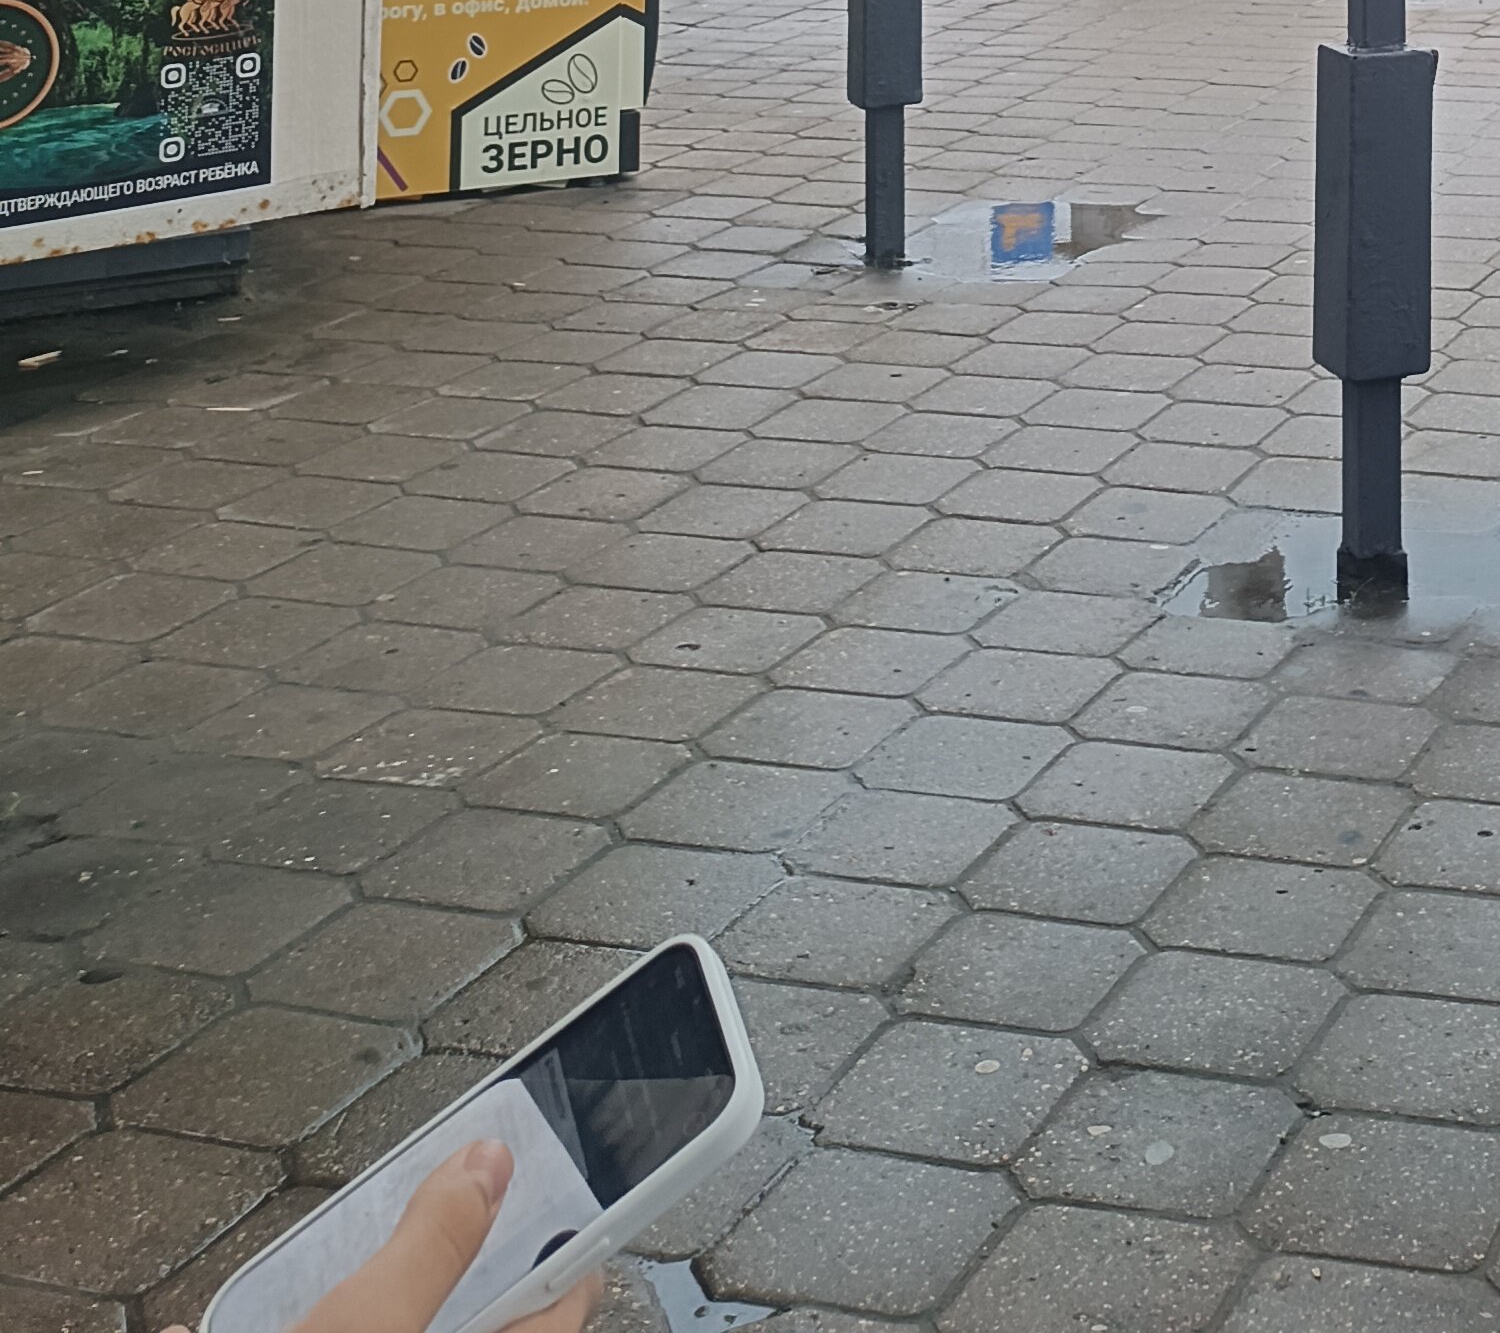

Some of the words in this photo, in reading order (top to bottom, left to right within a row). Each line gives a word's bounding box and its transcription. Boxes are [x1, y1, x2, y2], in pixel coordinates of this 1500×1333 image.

[434, 2, 446, 16] в
[483, 106, 609, 140] ЦЕЛЬНОЕ
[481, 134, 609, 174] ЗЕРНО
[0, 181, 134, 217] ДТВЕРЖДАЮЩЕГО
[136, 170, 196, 193] ВОЗРАСТ
[199, 161, 260, 183] РЕБЁНКА
